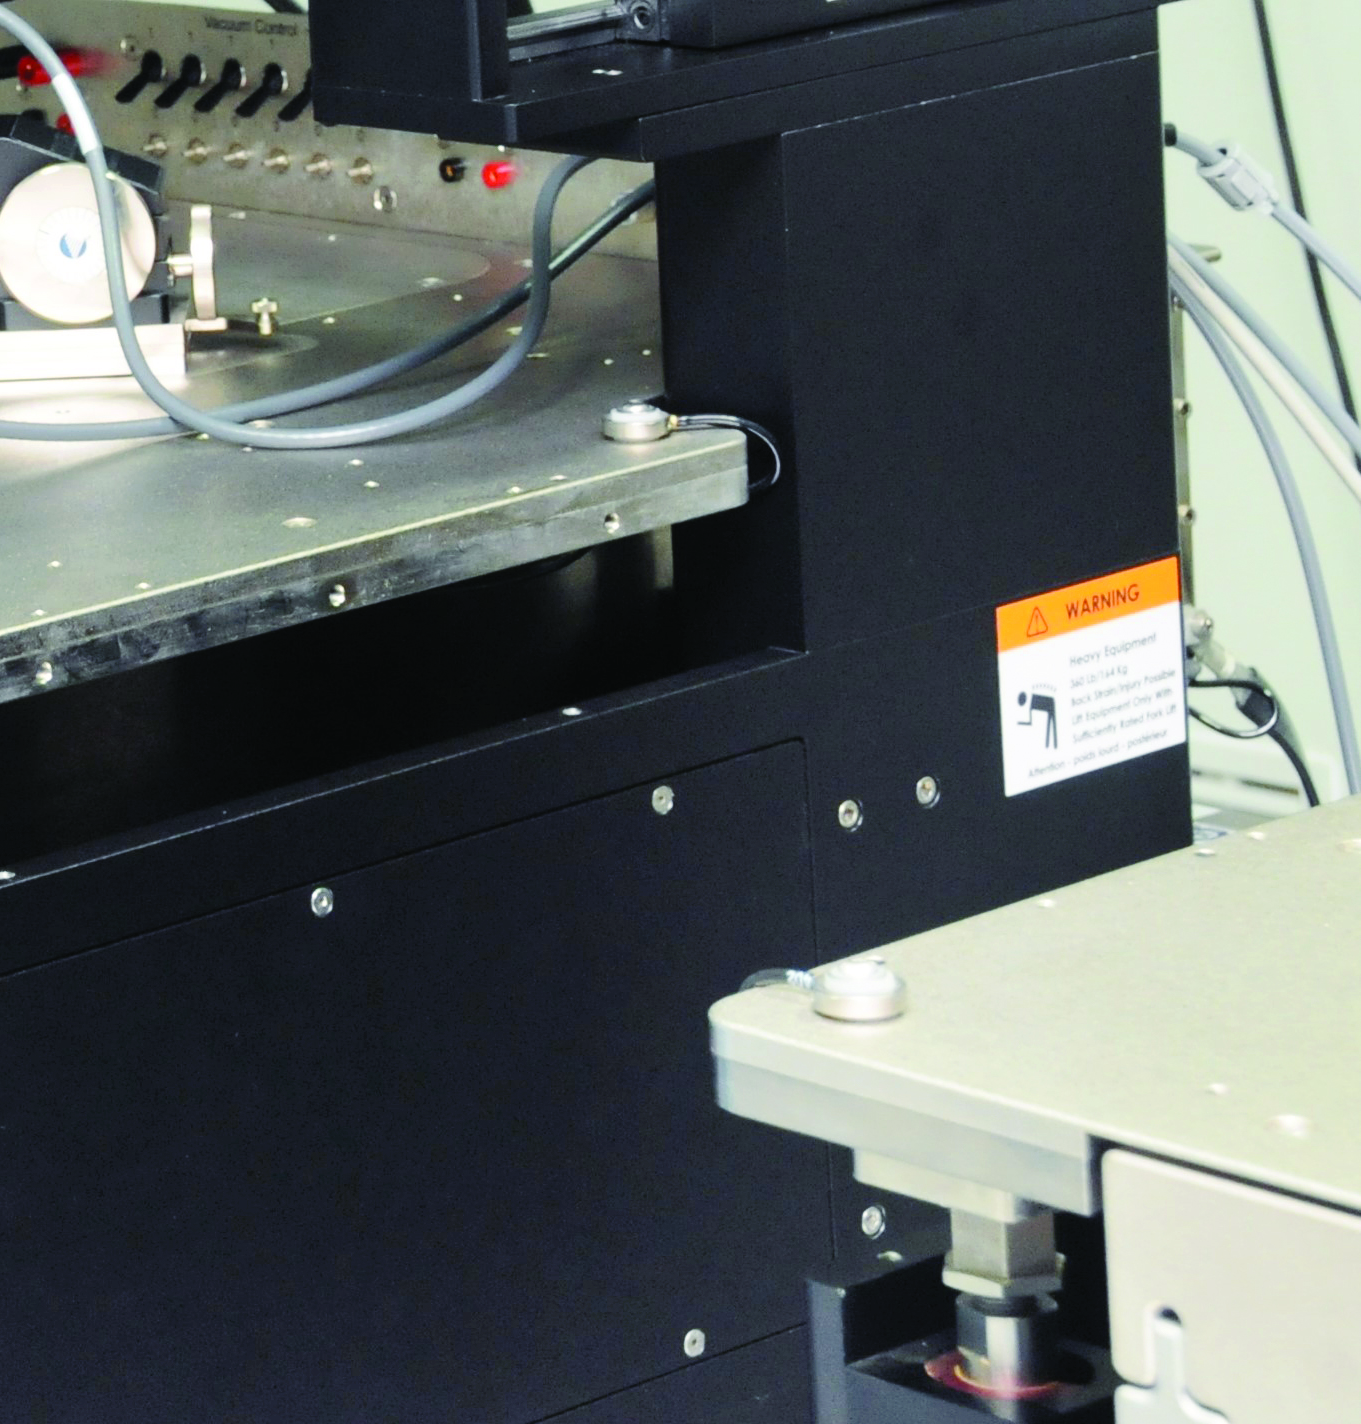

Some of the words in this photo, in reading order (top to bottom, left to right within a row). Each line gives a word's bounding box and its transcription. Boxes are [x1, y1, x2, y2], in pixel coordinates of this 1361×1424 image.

[1065, 583, 1140, 619] WARNING
[1070, 650, 1100, 666] Heavy
[1104, 633, 1157, 658] Equipment
